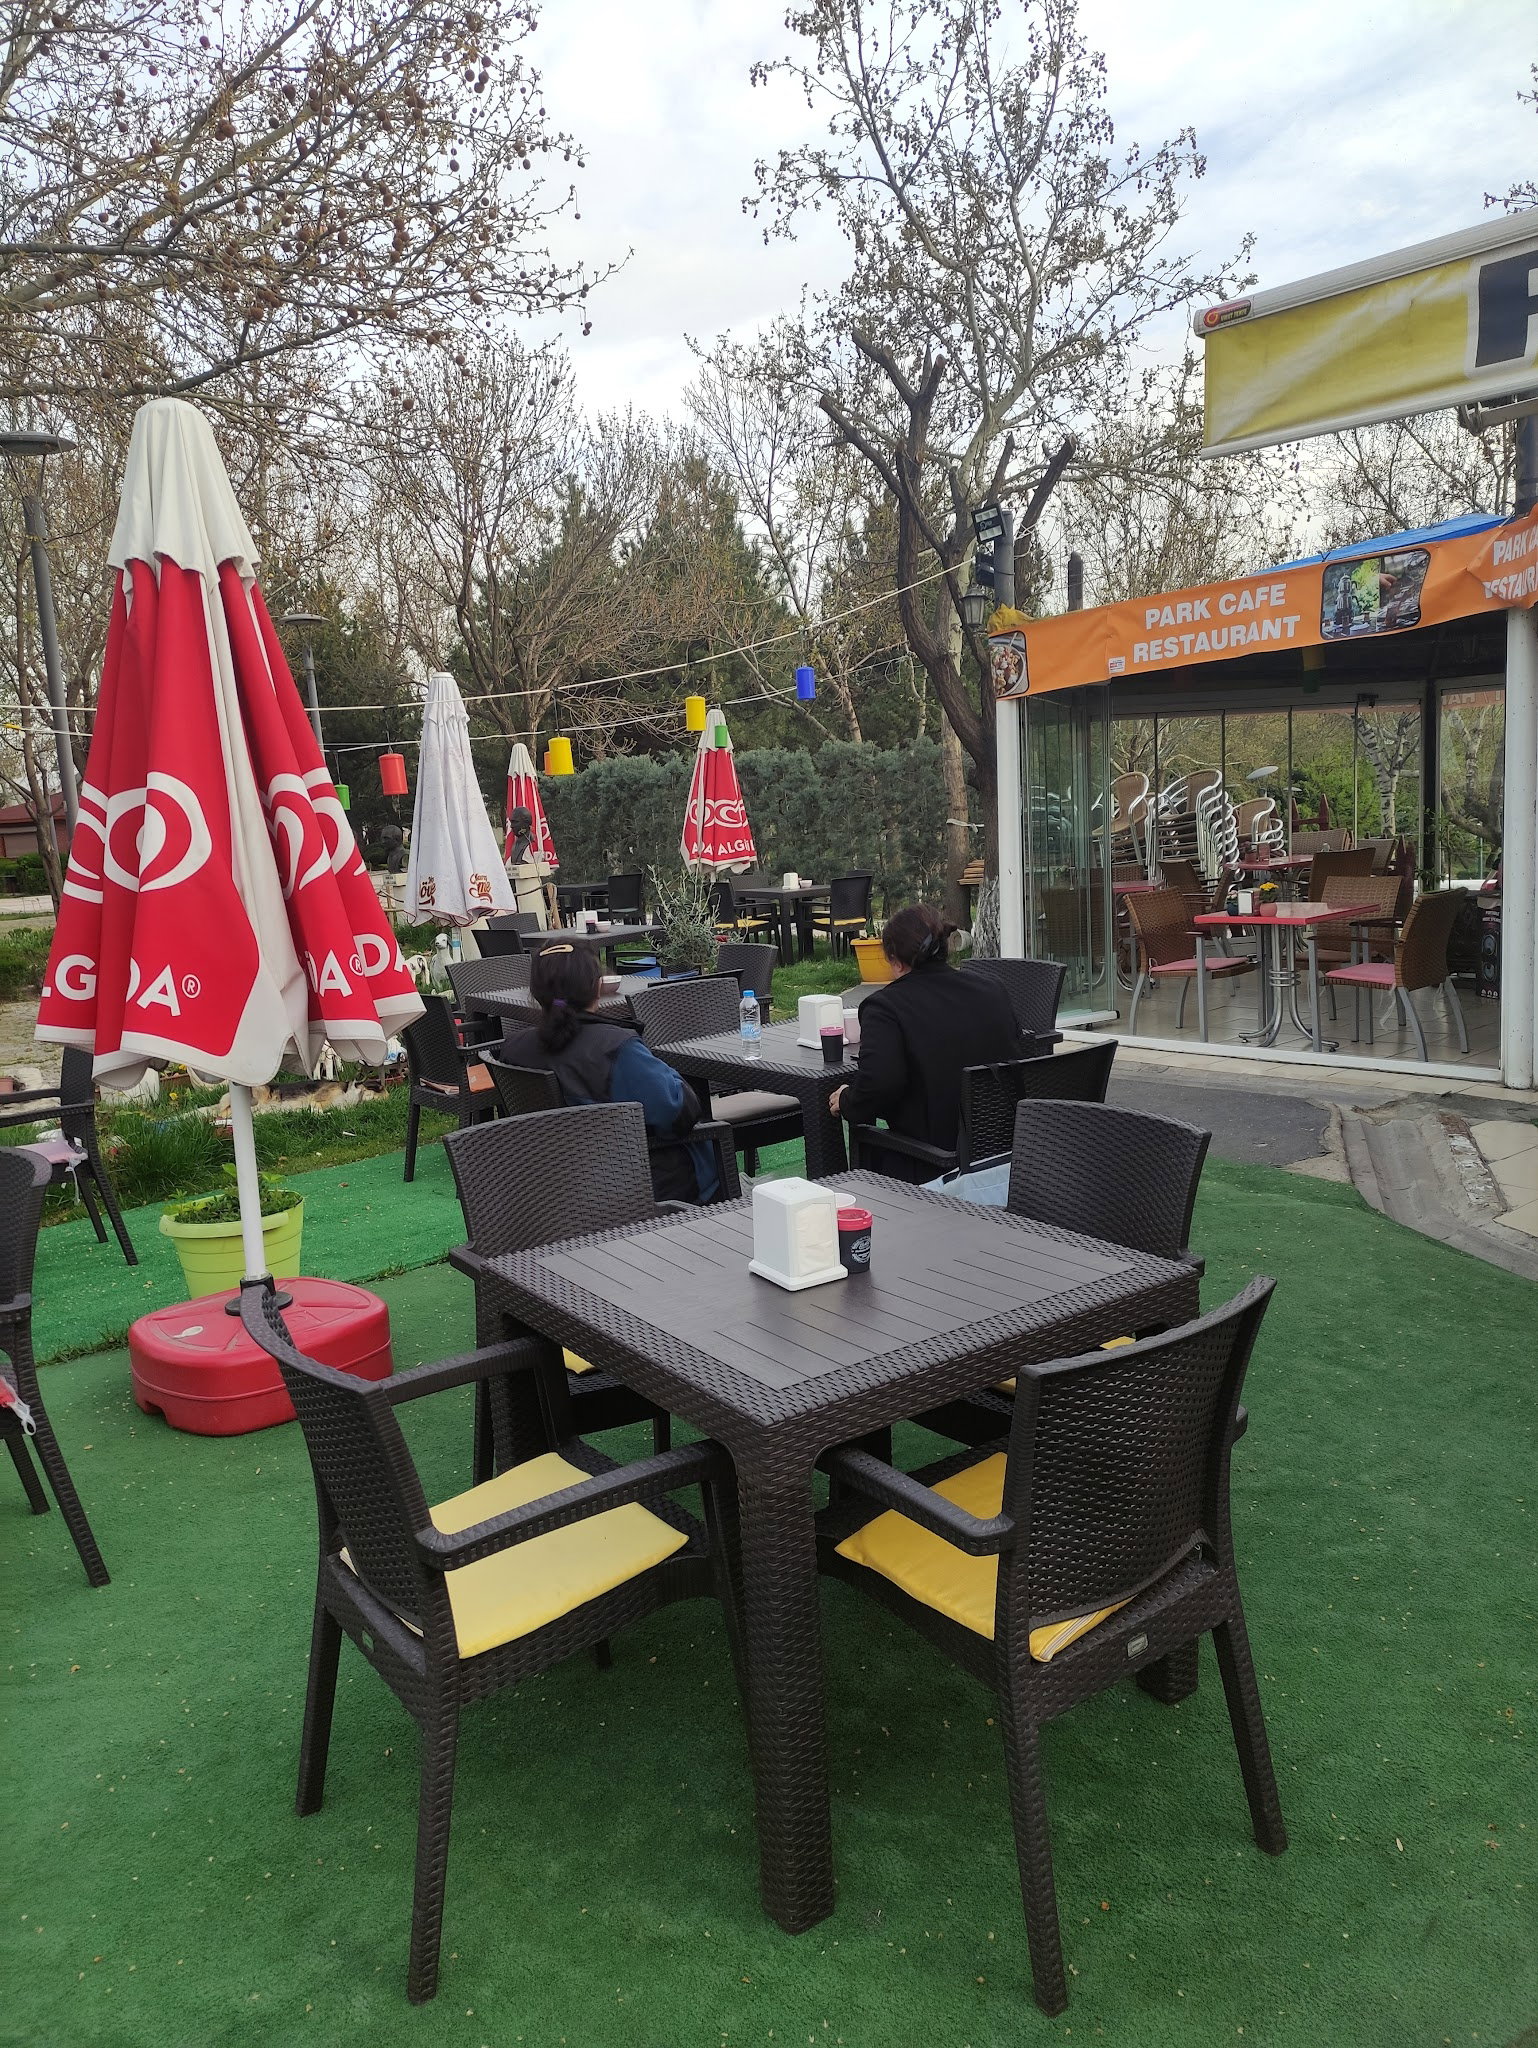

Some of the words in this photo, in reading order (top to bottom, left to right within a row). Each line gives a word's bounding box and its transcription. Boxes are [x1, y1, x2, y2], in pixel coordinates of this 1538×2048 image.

[1493, 528, 1530, 566] PARK
[1145, 598, 1212, 630] PARK
[1218, 583, 1287, 616] CAFE
[1133, 615, 1301, 663] RESTAURANT
